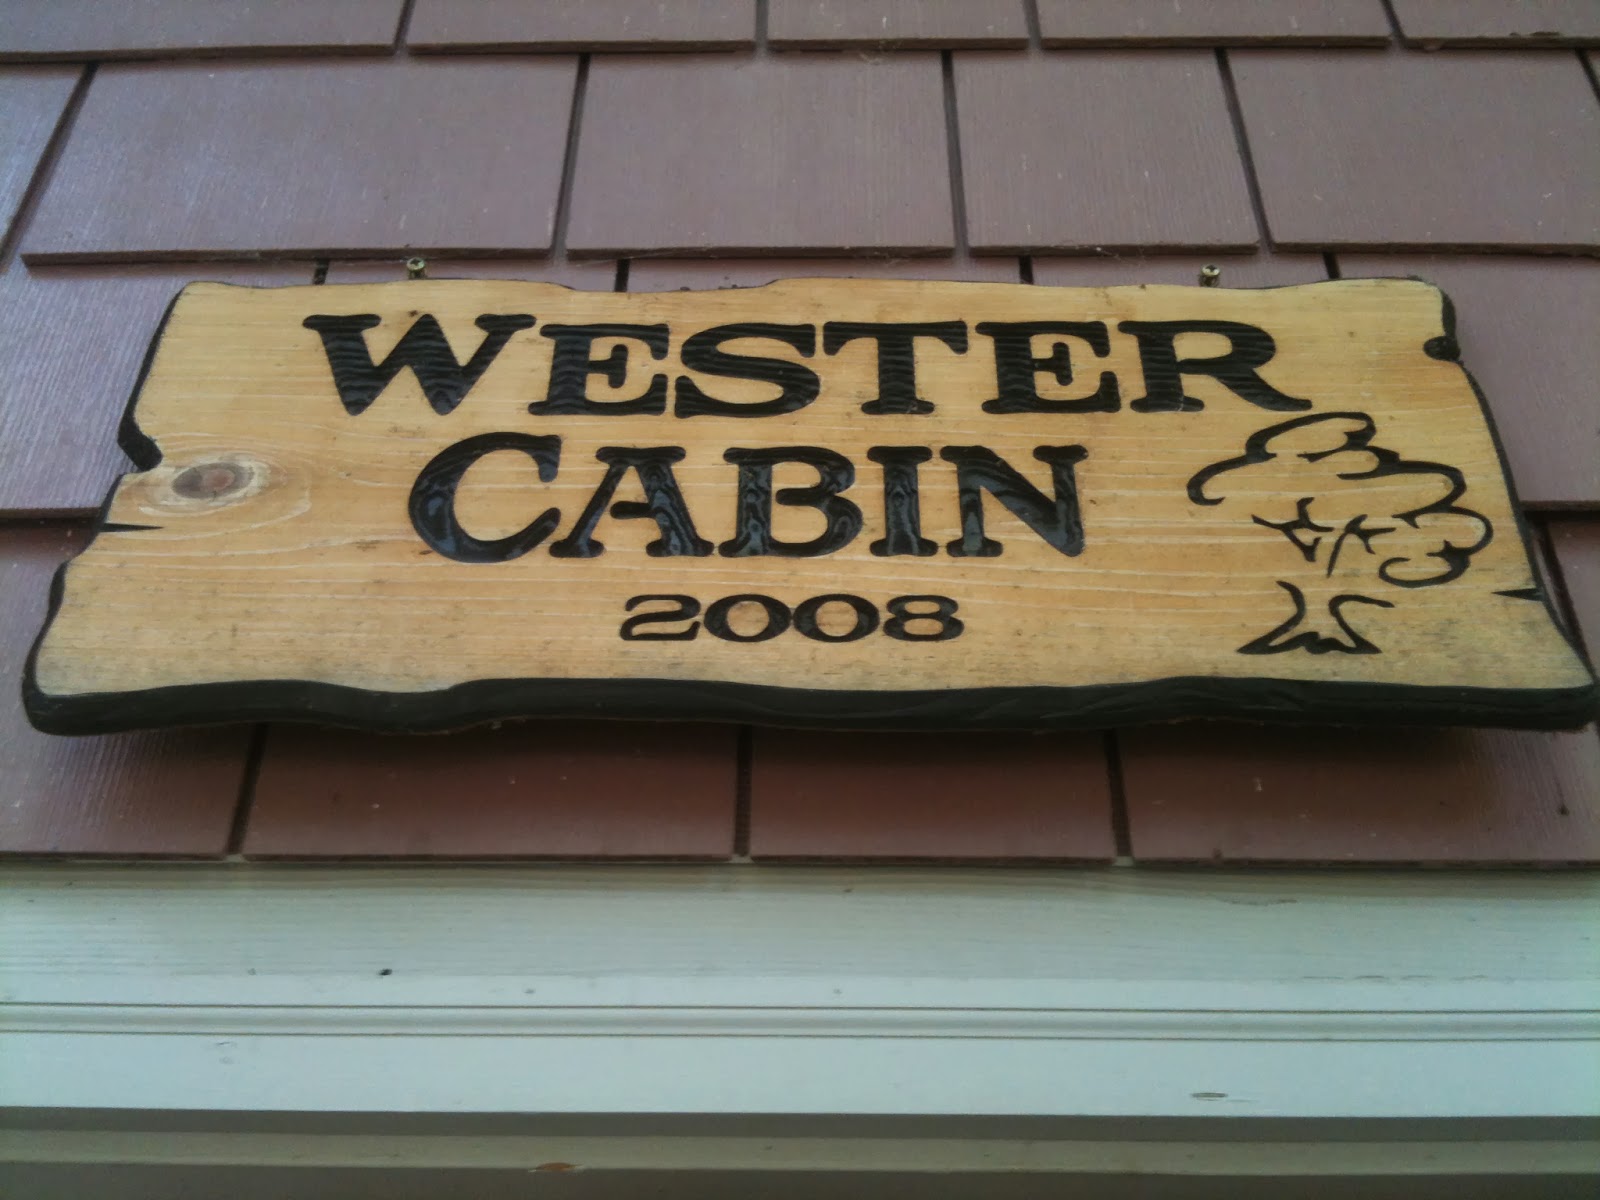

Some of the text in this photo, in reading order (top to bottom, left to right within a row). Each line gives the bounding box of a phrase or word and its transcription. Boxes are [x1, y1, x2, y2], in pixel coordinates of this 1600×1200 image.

[303, 313, 1312, 418] WESTER
[408, 431, 1088, 563] CABIN
[619, 593, 965, 643] 2008
